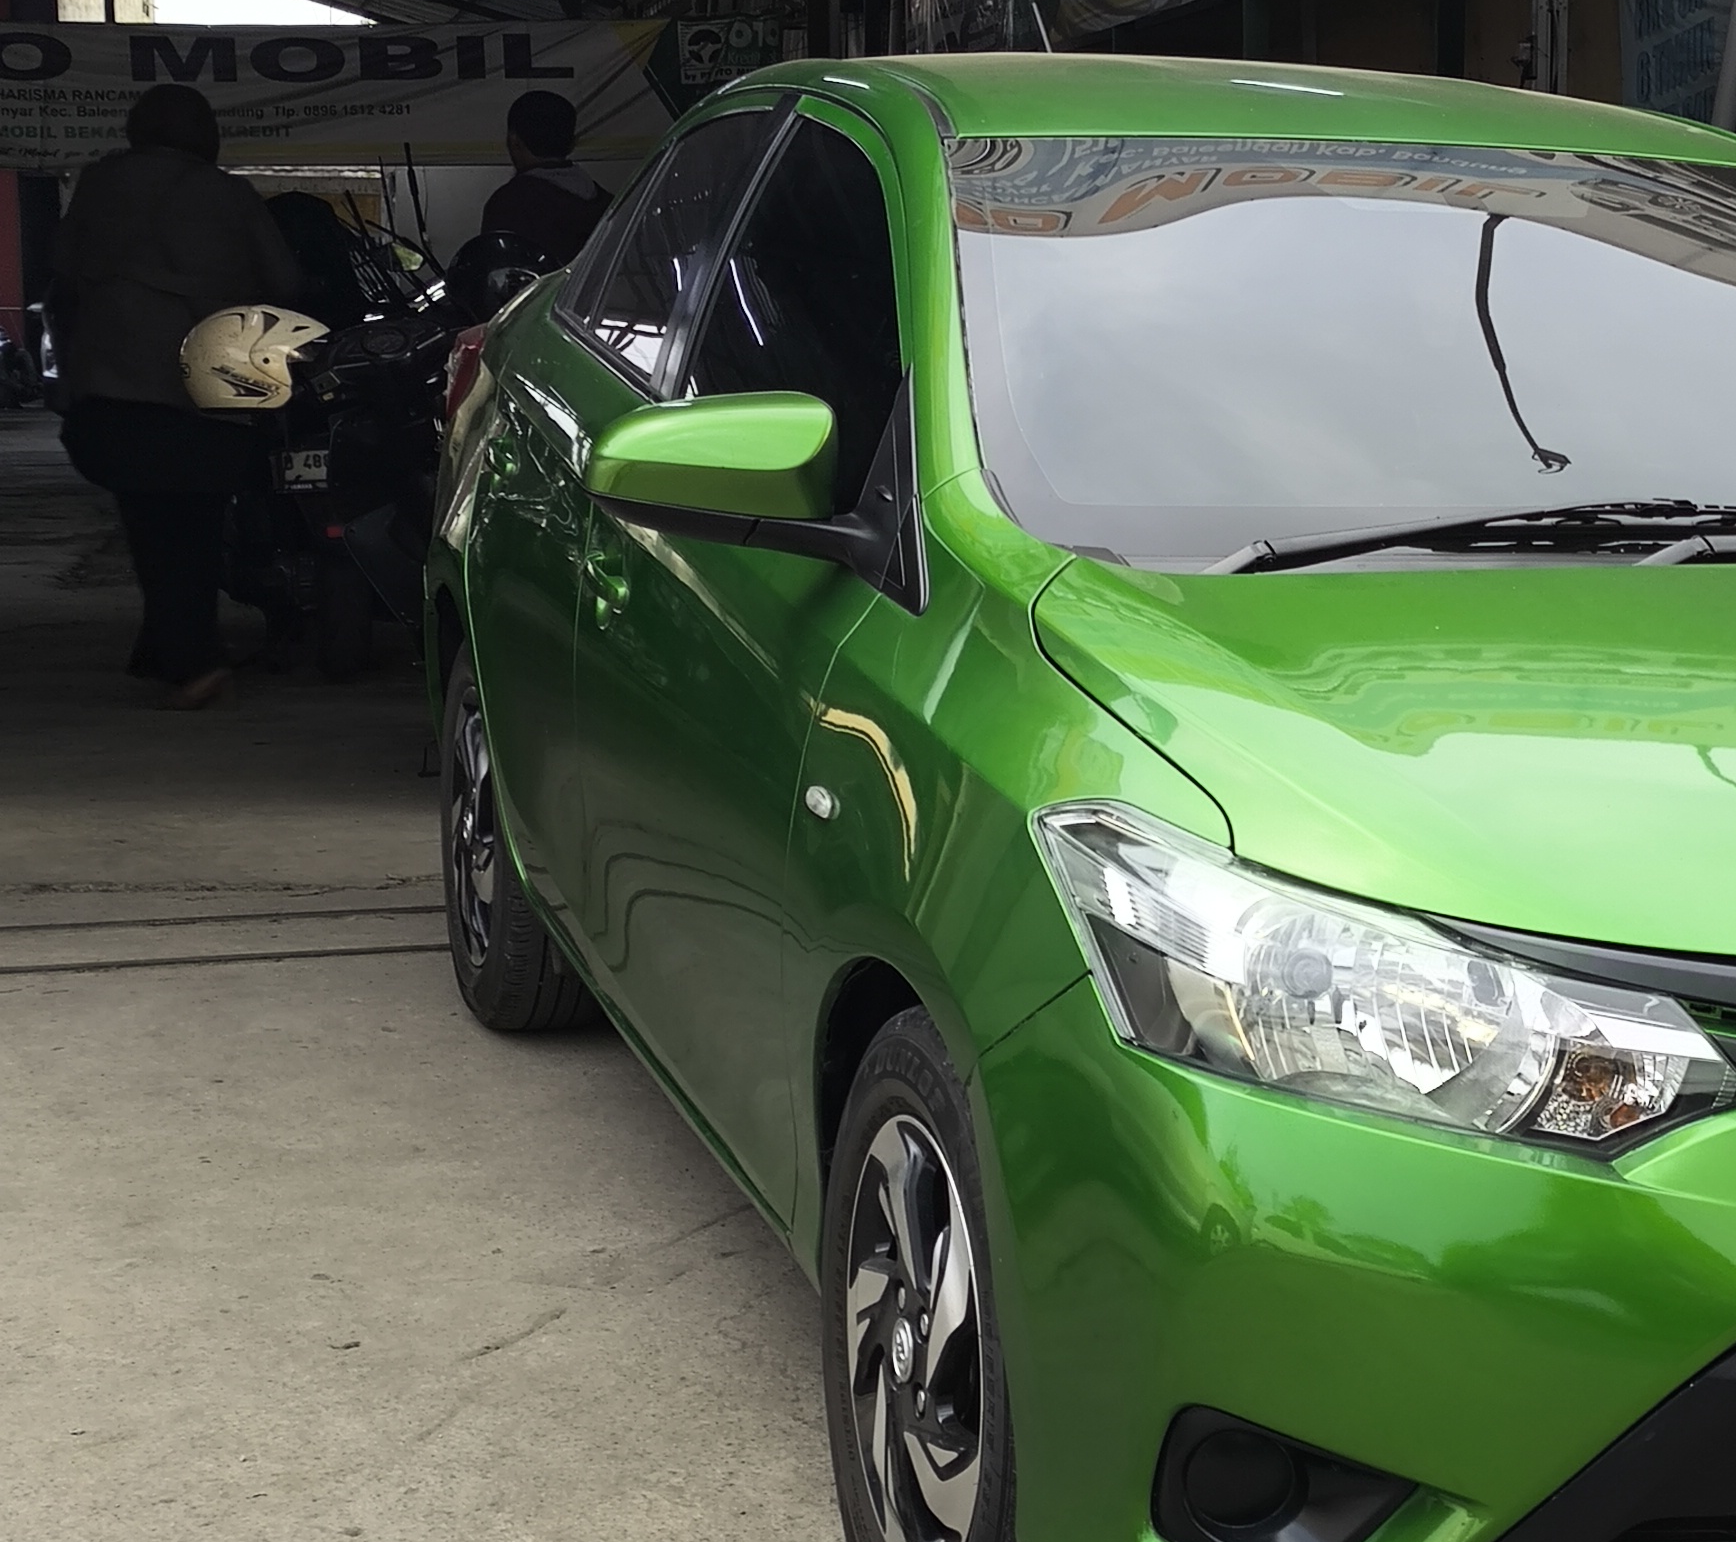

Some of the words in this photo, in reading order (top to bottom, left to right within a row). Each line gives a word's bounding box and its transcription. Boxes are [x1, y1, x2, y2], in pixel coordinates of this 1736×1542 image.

[129, 35, 574, 82] MOBIL
[72, 89, 143, 102] RANCAM
[273, 106, 299, 119] Tlp.
[303, 105, 337, 117] 0896
[343, 105, 374, 116] 1512
[380, 104, 411, 115] 4281
